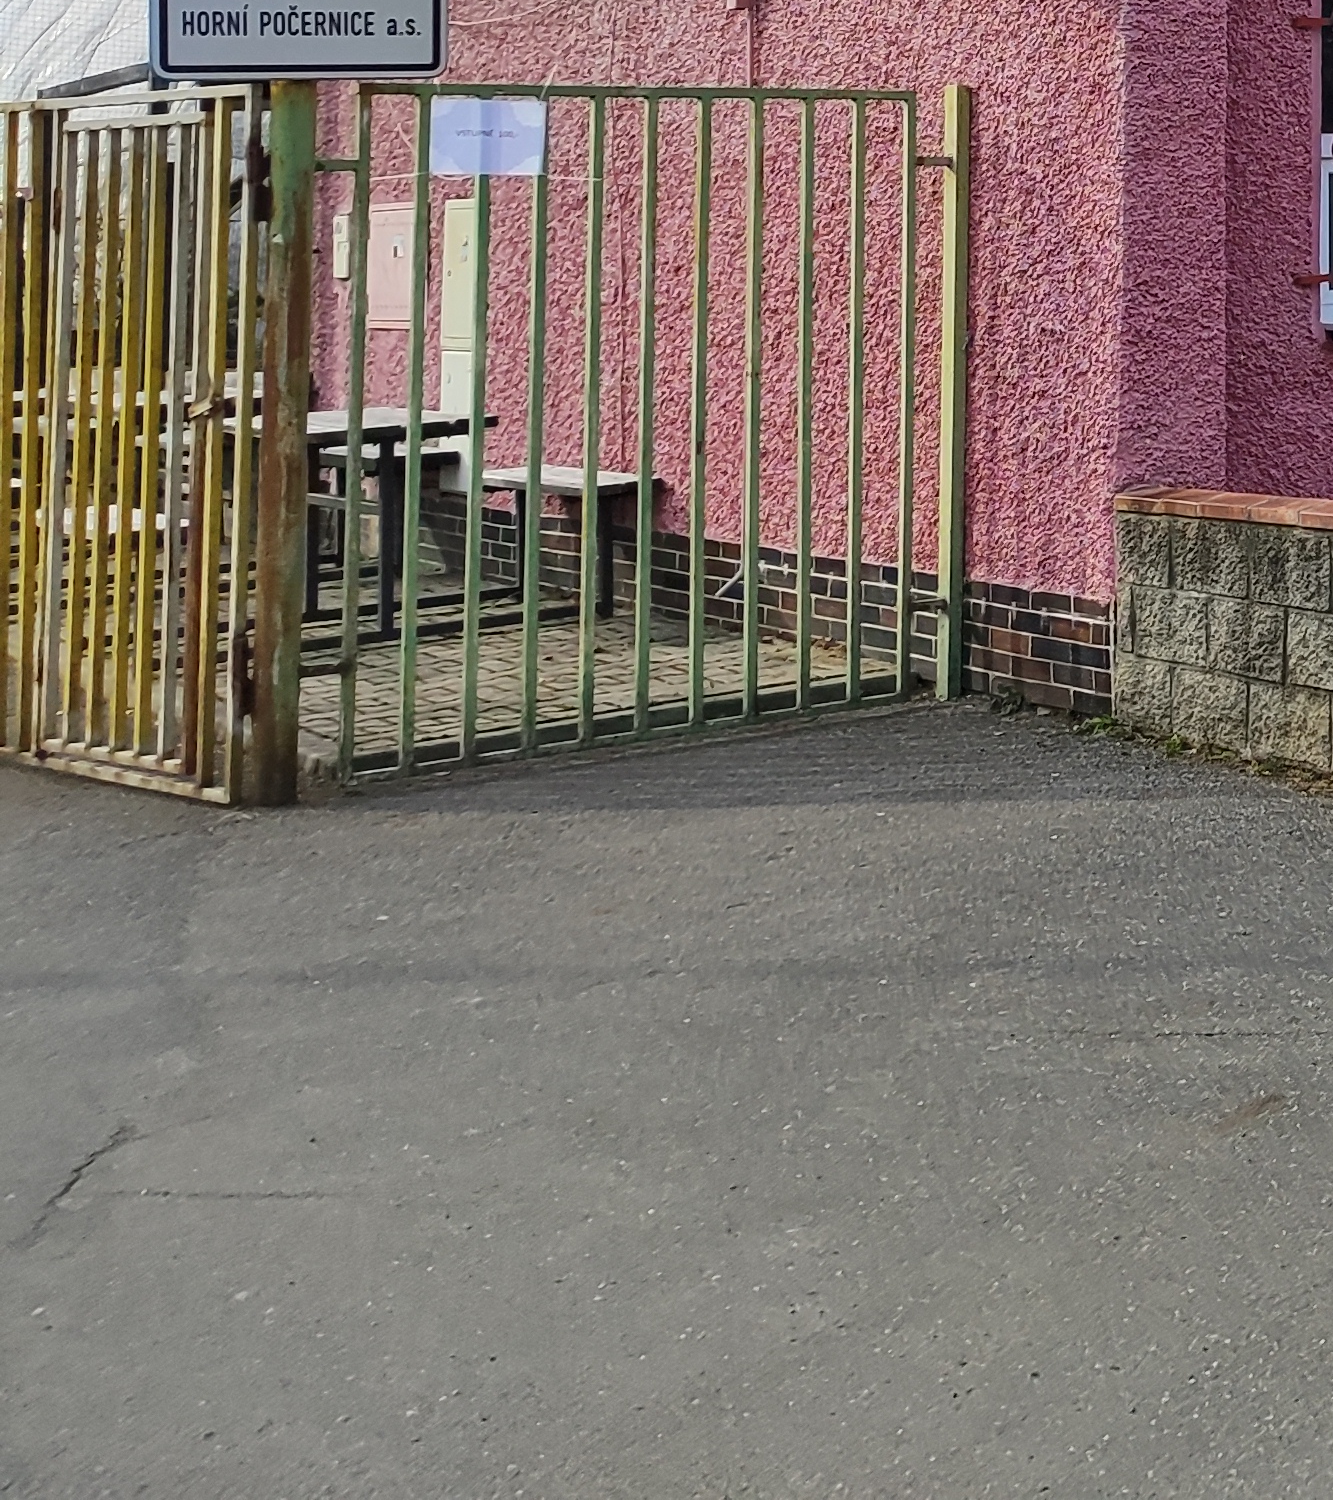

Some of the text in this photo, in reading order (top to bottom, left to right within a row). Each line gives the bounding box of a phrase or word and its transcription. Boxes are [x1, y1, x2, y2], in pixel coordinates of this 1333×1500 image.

[181, 4, 422, 37] HORNÍ POČERNICE a.s.
